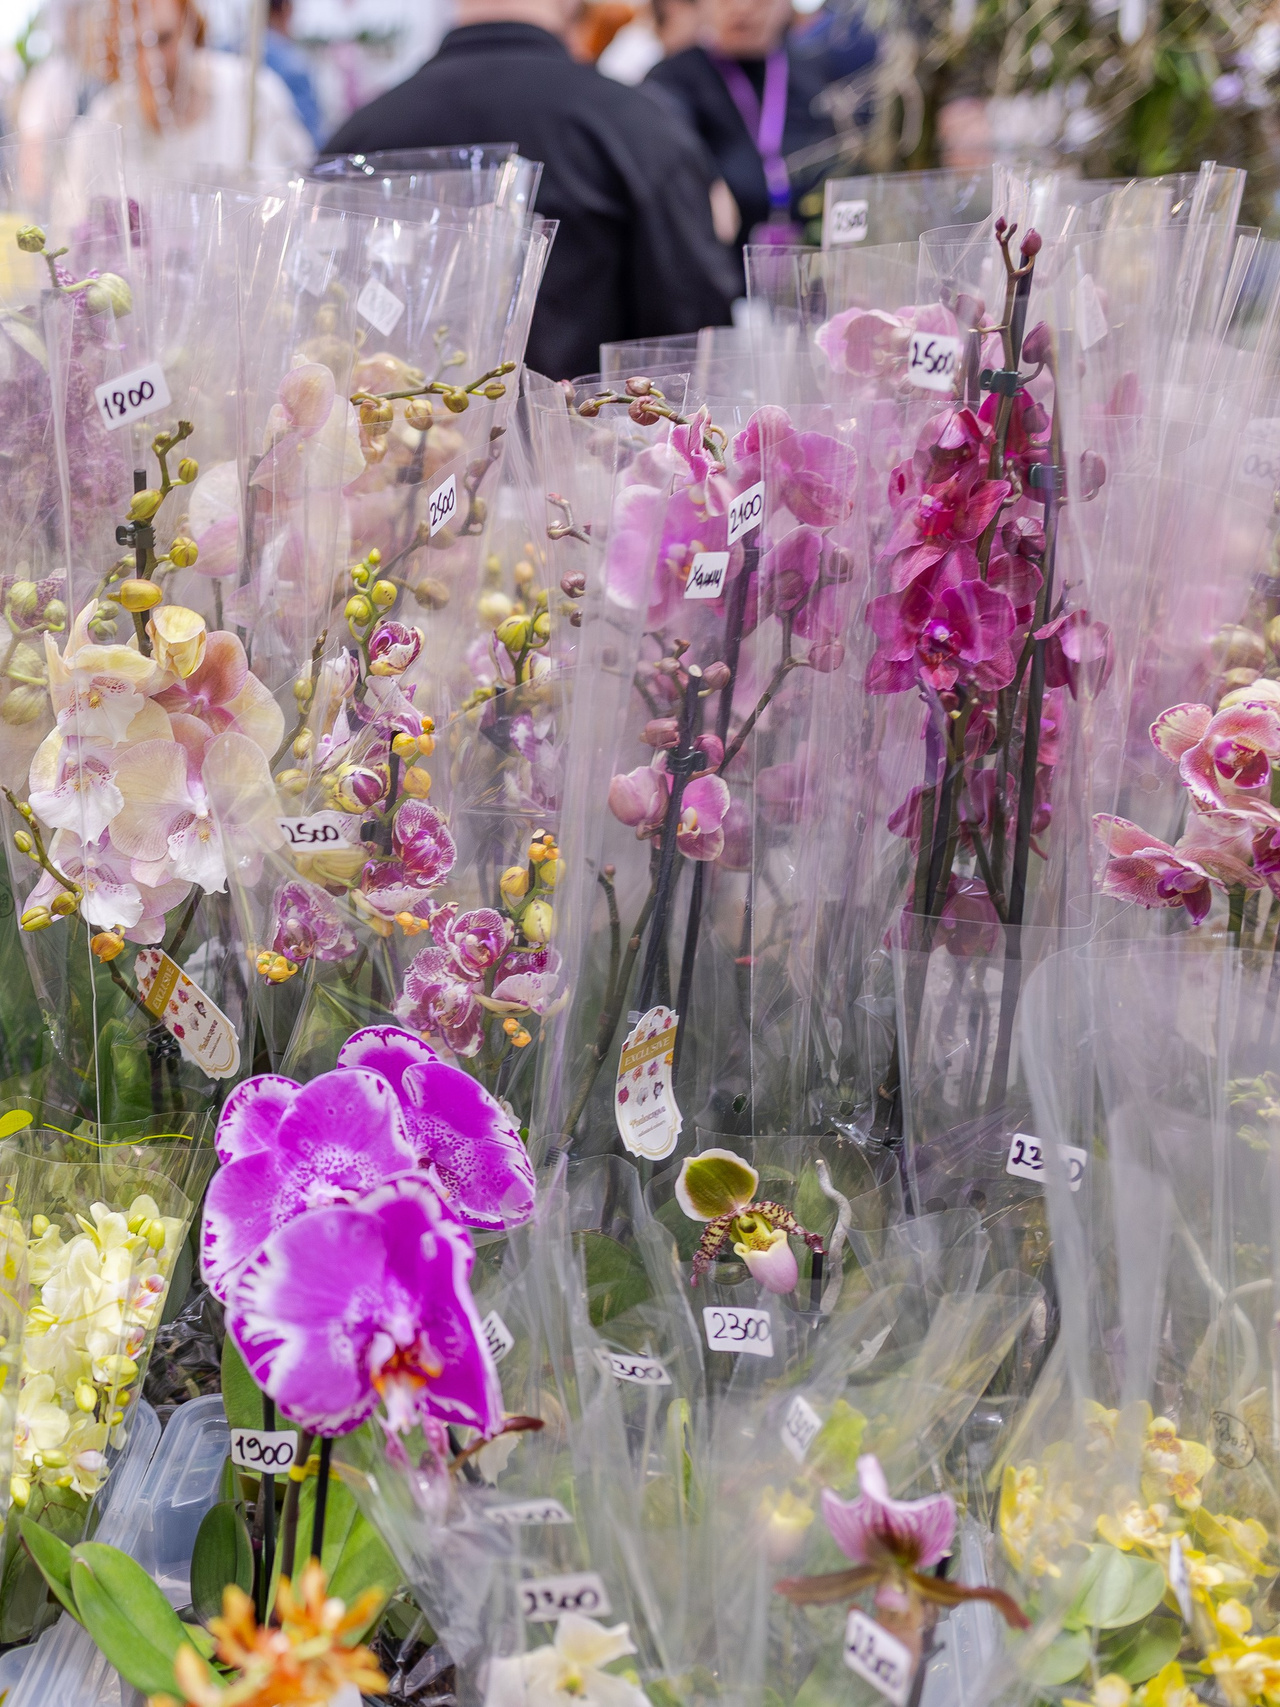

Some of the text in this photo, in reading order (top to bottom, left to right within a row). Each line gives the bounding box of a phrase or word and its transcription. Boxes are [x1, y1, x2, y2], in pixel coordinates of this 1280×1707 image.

[280, 822, 340, 844] 2500
[1011, 1140, 1084, 1183] 230
[710, 1312, 770, 1342] 2300
[235, 1434, 295, 1466] 1900
